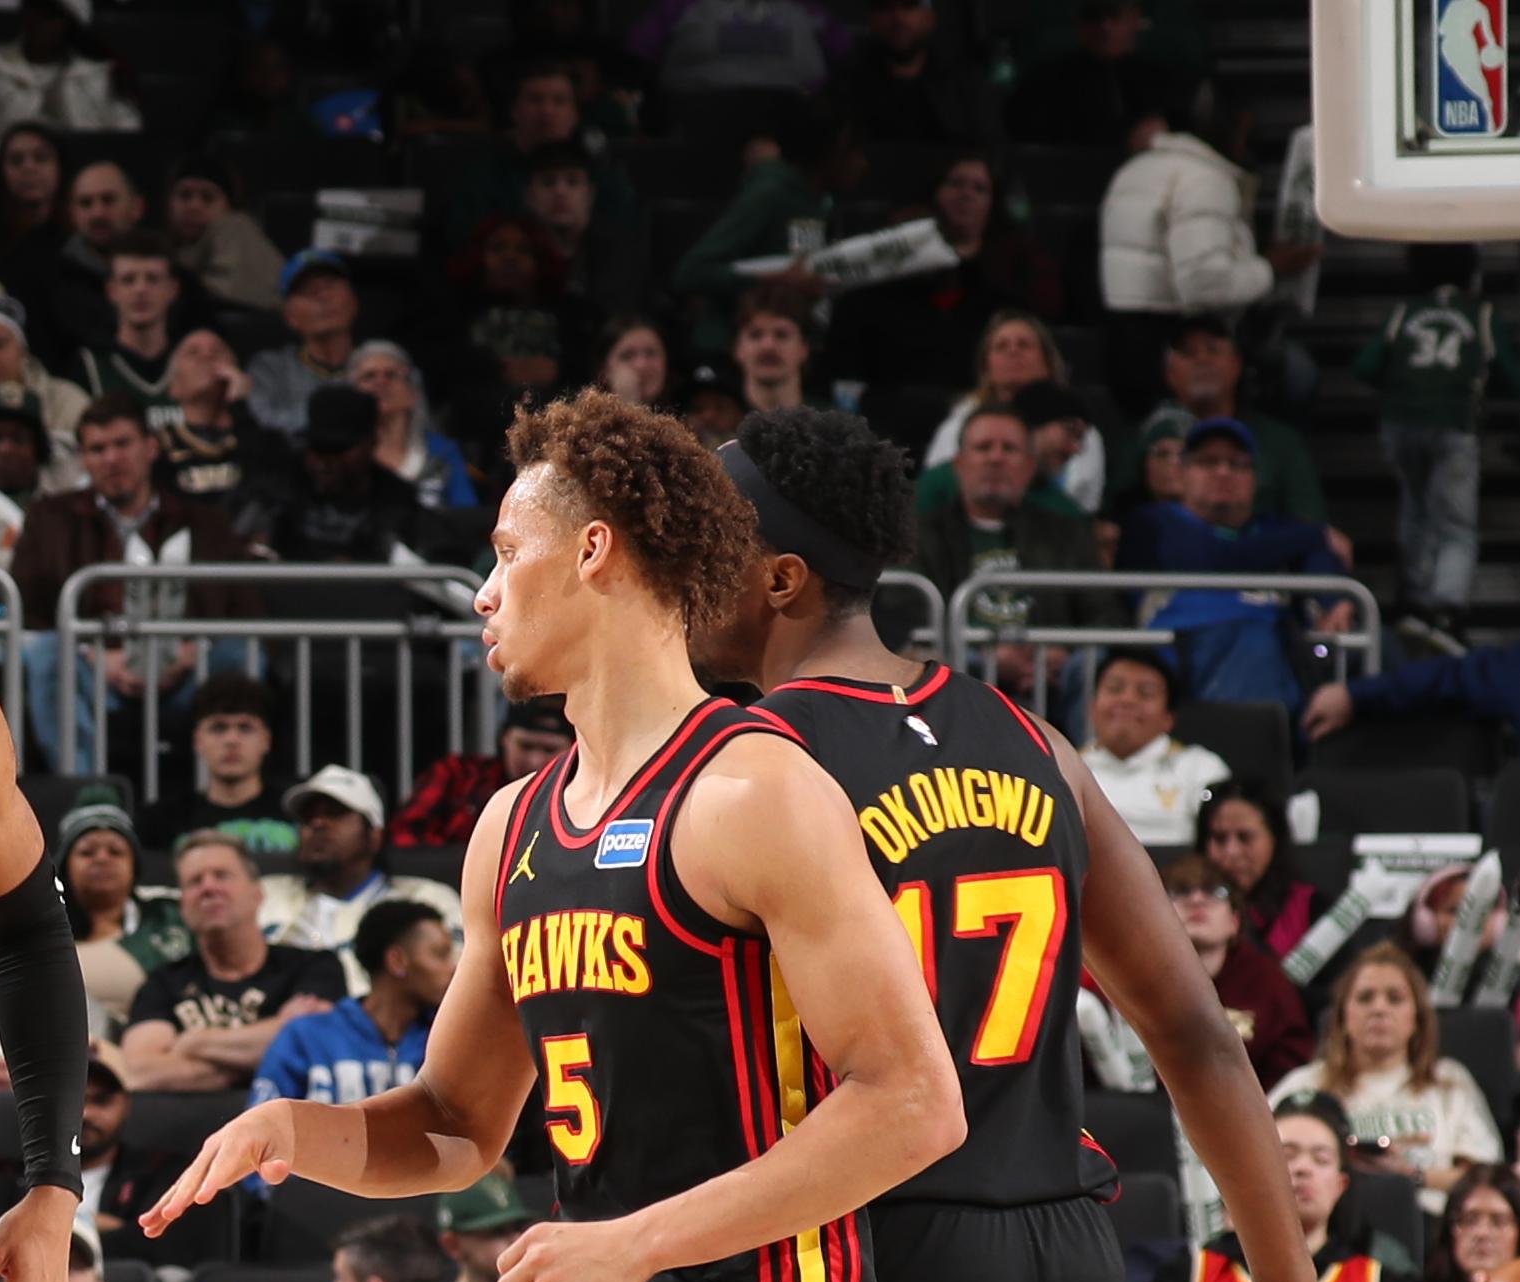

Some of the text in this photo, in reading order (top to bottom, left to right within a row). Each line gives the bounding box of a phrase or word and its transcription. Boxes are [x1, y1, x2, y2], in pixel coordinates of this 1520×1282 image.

[1445, 100, 1479, 126] NBA
[602, 830, 647, 856] paze
[859, 766, 1055, 864] OKONGWU
[501, 908, 653, 1007] HAWKS
[540, 1032, 603, 1166] 5
